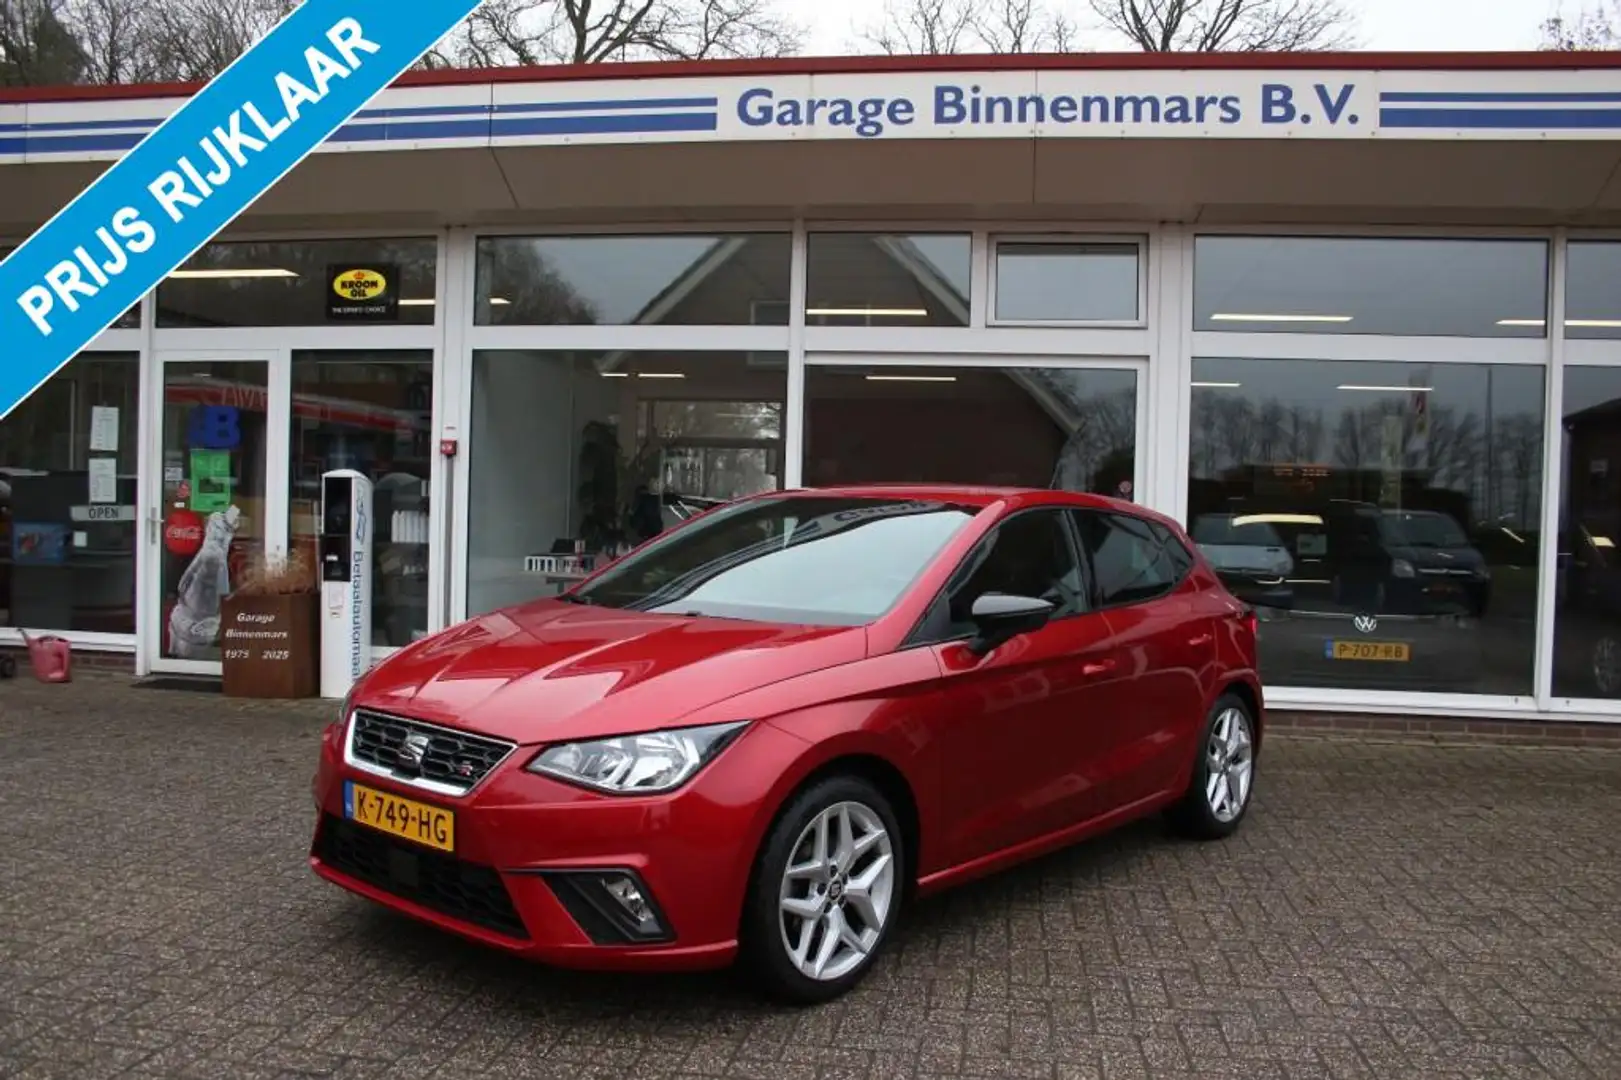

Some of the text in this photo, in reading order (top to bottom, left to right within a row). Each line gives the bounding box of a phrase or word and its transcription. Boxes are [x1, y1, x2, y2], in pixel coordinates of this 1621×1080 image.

[737, 83, 1359, 137] Garage Binnenmars B.V.
[341, 280, 378, 289] KROON
[89, 507, 119, 519] OPEN
[237, 613, 275, 624] Garage
[225, 629, 288, 638] Binnenmars
[357, 791, 447, 844] K-749-HG
